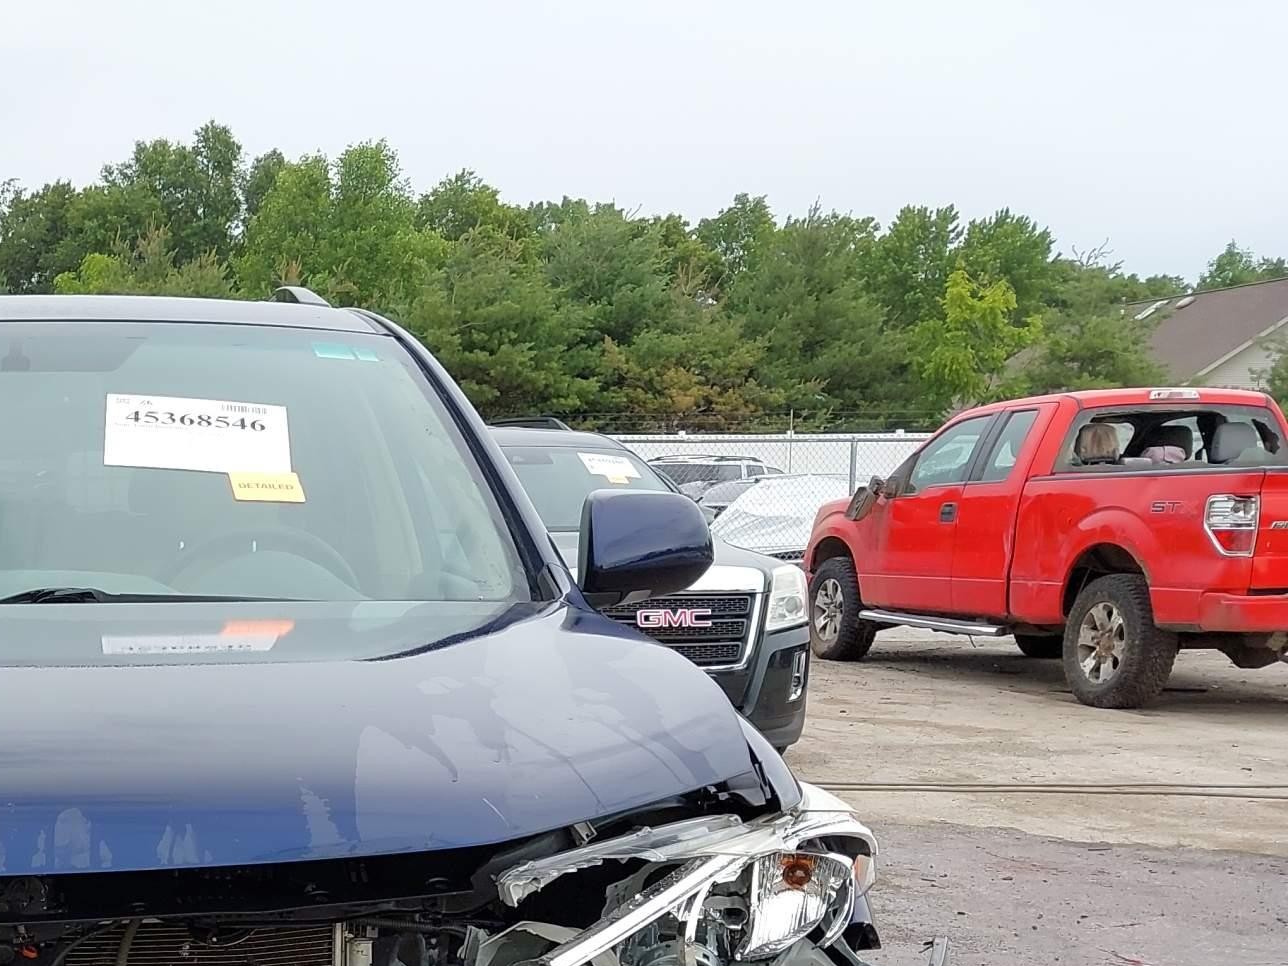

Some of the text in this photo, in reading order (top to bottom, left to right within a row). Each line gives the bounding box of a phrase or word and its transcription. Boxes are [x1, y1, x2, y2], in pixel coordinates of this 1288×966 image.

[125, 410, 266, 432] 45368546
[238, 481, 294, 491] DETAILED
[636, 609, 712, 627] GMC
